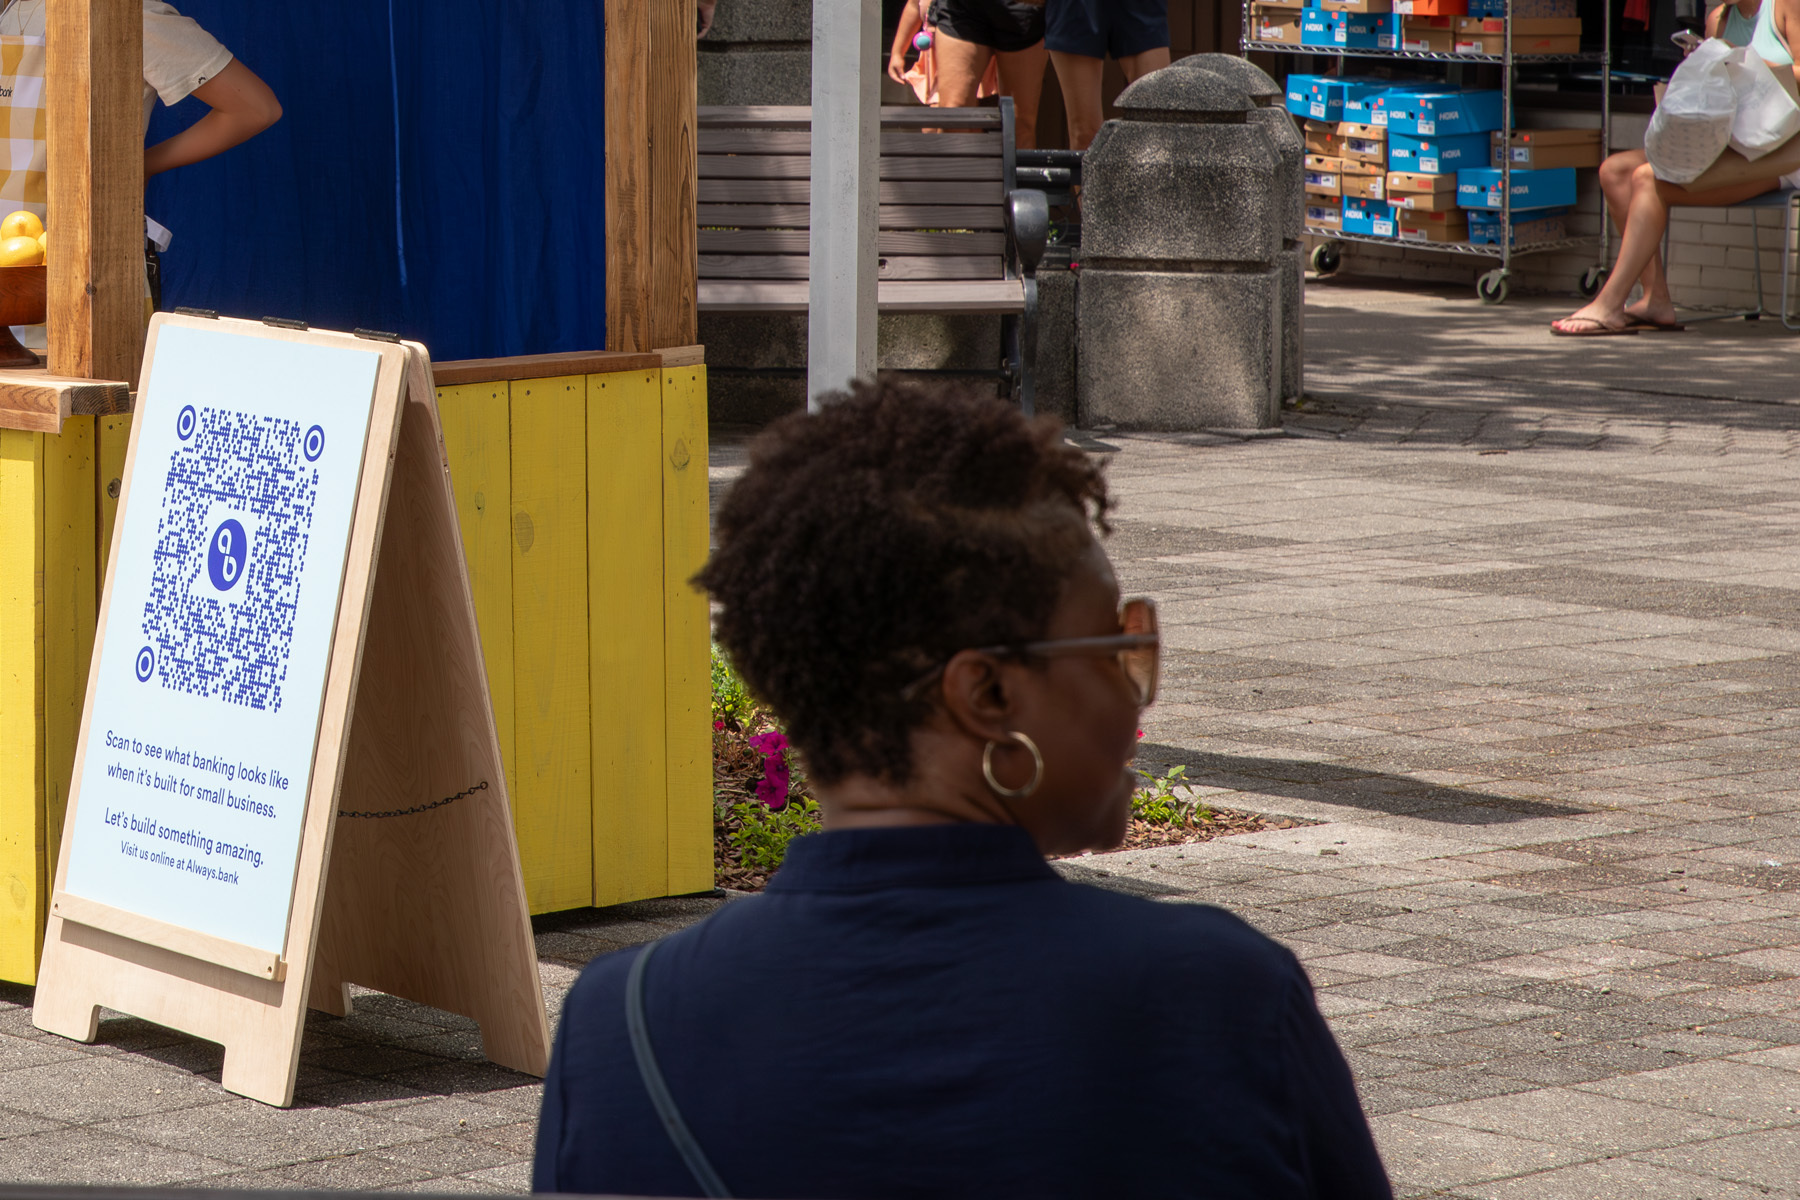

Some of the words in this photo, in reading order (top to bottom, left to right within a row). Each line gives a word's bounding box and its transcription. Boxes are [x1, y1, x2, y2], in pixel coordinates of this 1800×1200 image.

[106, 730, 129, 751] Scan
[132, 738, 142, 754] to
[145, 744, 162, 759] see
[165, 746, 190, 766] what
[192, 751, 235, 781] banking
[238, 762, 266, 785] looks
[269, 770, 288, 790] like
[108, 762, 134, 782] when
[137, 767, 151, 787] it's
[154, 772, 177, 793] built
[180, 779, 194, 797] for
[197, 787, 225, 805] small
[227, 790, 276, 818] business.
[105, 807, 128, 828] Let's
[131, 814, 156, 836] build
[158, 826, 213, 855] something
[216, 841, 264, 868] amazing.
[121, 840, 138, 858] Visit
[140, 848, 148, 860] us
[150, 851, 175, 867] online
[176, 858, 185, 870] at
[186, 859, 239, 885] Always.bank
